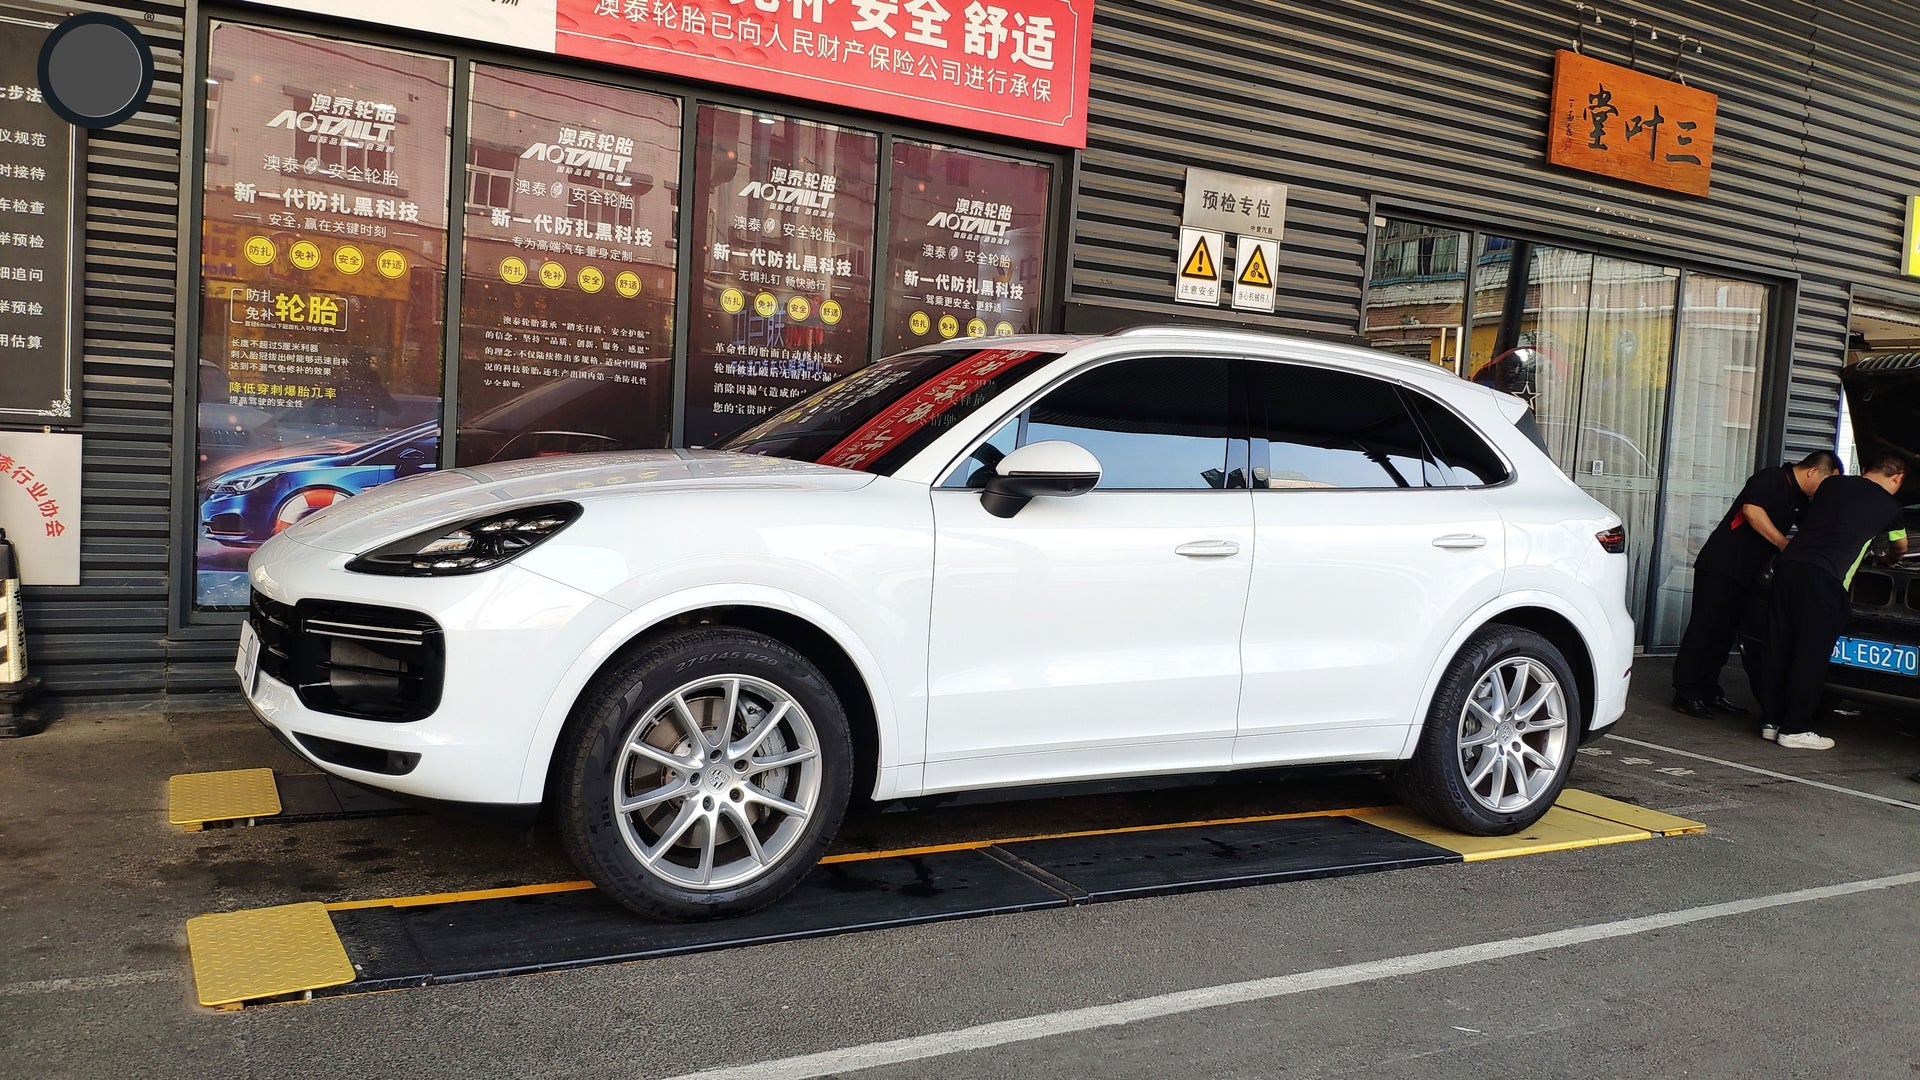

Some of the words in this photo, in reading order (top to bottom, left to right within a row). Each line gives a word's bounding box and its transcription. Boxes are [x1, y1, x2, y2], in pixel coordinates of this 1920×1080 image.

[964, 0, 1056, 70] 舒适
[594, 0, 1051, 103] 澳泰轮胎已向人民财产保险公司进行承保
[309, 92, 397, 124] 澳泰轮胎
[266, 109, 397, 142] AOTAILT
[0, 128, 47, 148] 仪规范
[557, 127, 634, 155] 澳泰轮胎
[519, 142, 633, 174] AOTAILT
[0, 163, 46, 182] 时接待
[327, 162, 399, 187] 安全轮胎
[770, 166, 837, 192] 澳泰轮胎
[0, 196, 46, 215] 车检查
[233, 181, 420, 223] 新一代防扎黑科技
[572, 187, 634, 210] 安全轮胎
[738, 181, 836, 209] AOTAILT
[1202, 189, 1271, 219] 预检专位
[955, 197, 1013, 221] 澳泰轮胎
[490, 207, 653, 248] 新一代防扎黑科技
[783, 222, 837, 243] 安全轮胎
[926, 211, 1012, 238] AOTAILT
[0, 231, 45, 249] 举预检
[512, 236, 633, 263] 专为高端汽车量身定制
[249, 243, 271, 257] 防扎
[294, 248, 317, 262] 免补
[338, 253, 360, 266] 安全
[381, 258, 403, 271] 舒适
[713, 242, 852, 278] 新一代防扎黑科技
[964, 249, 1012, 269] 安全轮胎
[503, 264, 523, 277] 防扎
[543, 269, 562, 281] 免补
[581, 274, 600, 286] 安全
[619, 279, 638, 290] 舒适
[738, 269, 781, 286] 无惧扎钉
[785, 276, 827, 291] 畅快驰行
[904, 269, 1024, 301] 新一代防扎黑科技
[246, 288, 275, 303] 防扎
[1181, 284, 1215, 297] 注意安全
[0, 299, 44, 316] 举预检
[245, 305, 275, 321] 免补
[275, 292, 339, 326] 轮胎
[723, 295, 741, 307] 防扎
[757, 299, 775, 310] 免补
[791, 303, 807, 314] 安全
[912, 318, 927, 329] 防扎
[231, 338, 319, 353] 长度不超过5厘米利器
[715, 342, 843, 364] 革命性的胎面自动修补技术
[230, 361, 331, 377] 达到不漏气免修补的效果
[229, 381, 337, 400] 降低穿刺爆胎几率
[229, 395, 304, 408] 提高驾驶的安全性
[713, 382, 807, 398] 消除因漏气造成的
[675, 651, 741, 673] 275/45
[744, 652, 779, 666] R20
